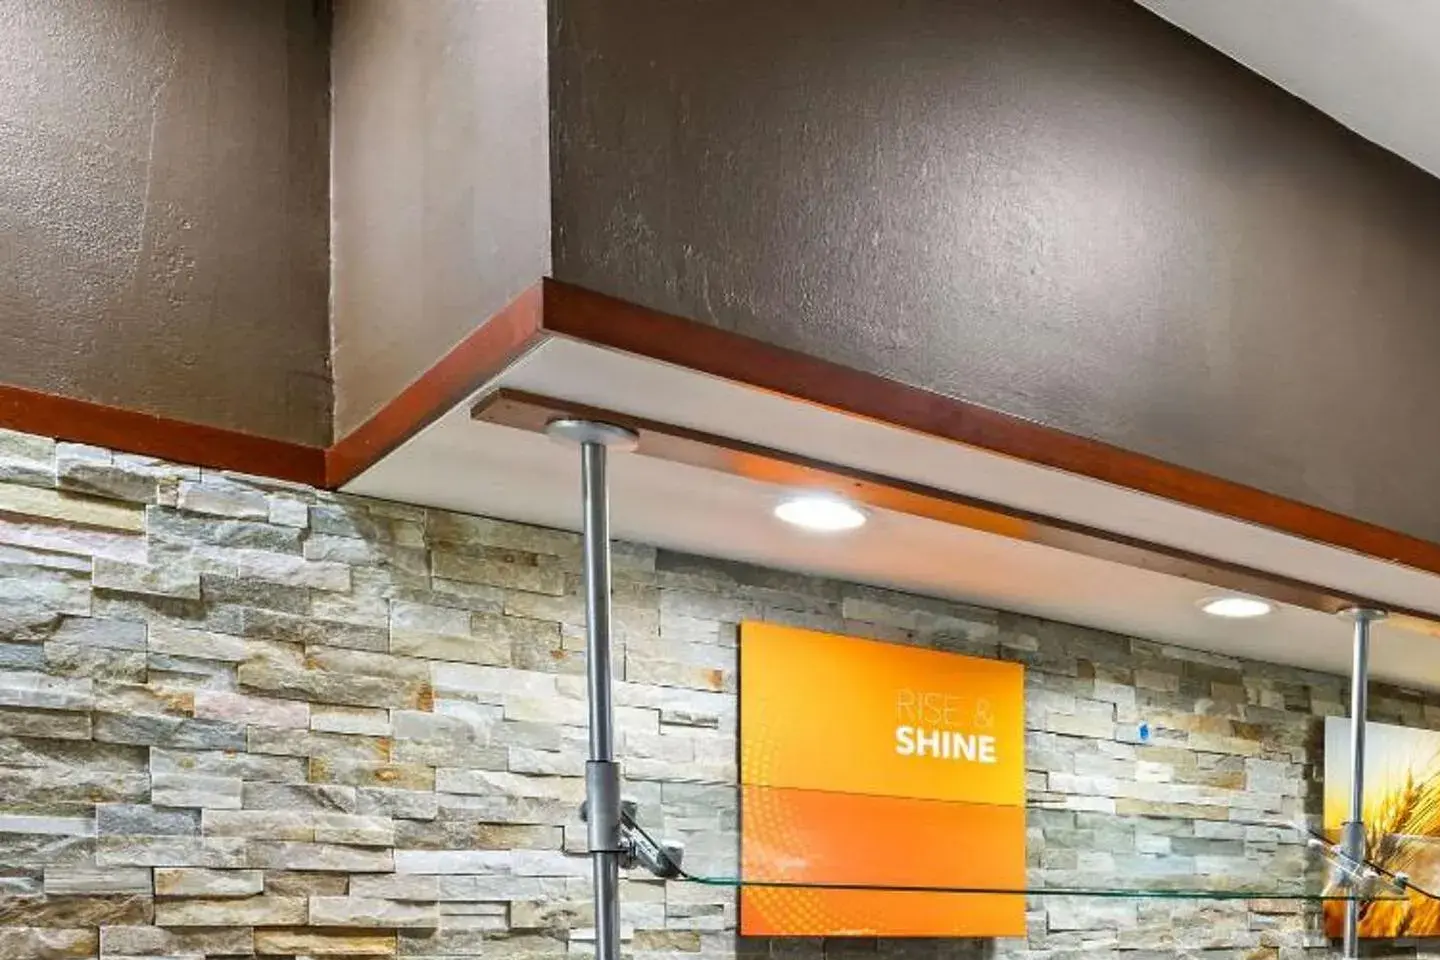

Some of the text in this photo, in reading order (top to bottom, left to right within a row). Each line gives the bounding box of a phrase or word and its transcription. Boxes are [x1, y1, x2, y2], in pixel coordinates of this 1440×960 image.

[896, 688, 994, 727] RISE &
[895, 725, 997, 763] SHINE
